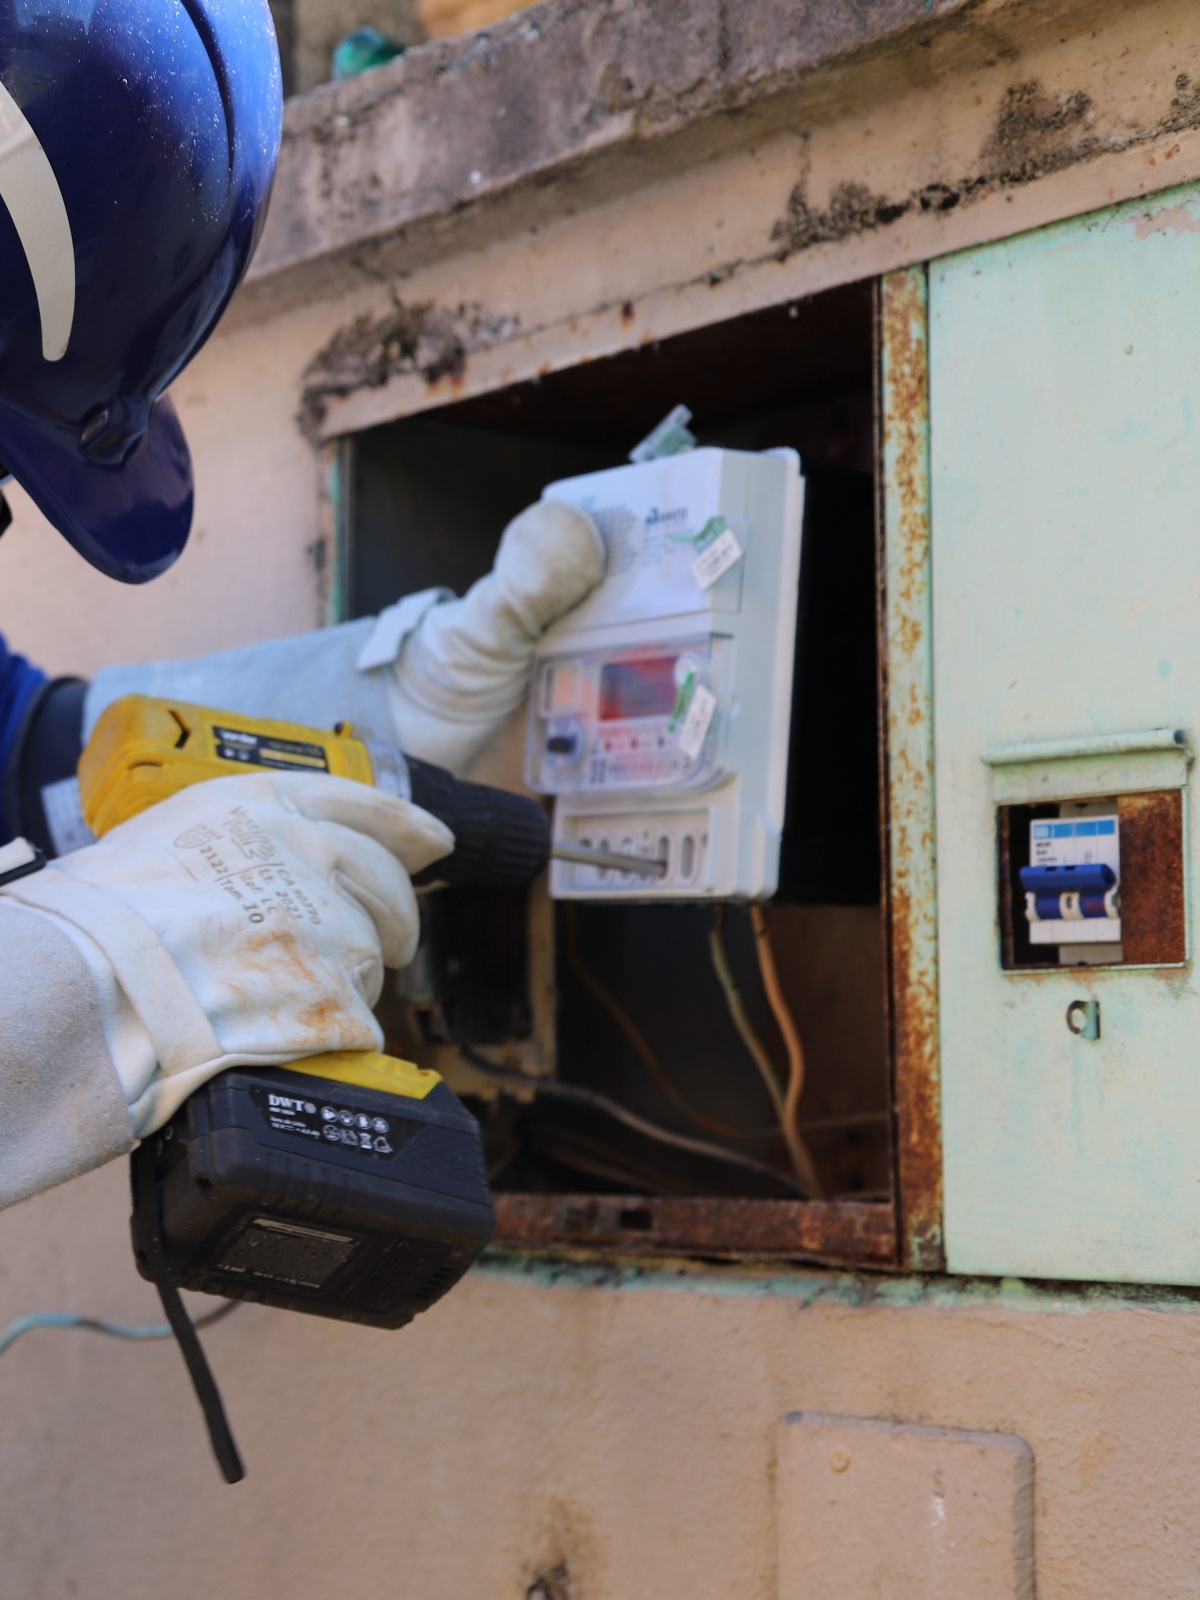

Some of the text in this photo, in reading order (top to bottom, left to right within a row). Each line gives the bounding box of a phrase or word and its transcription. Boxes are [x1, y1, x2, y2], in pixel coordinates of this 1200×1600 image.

[200, 846, 229, 875] 2122
[277, 868, 296, 887] CA
[218, 879, 265, 924] Tam: 10
[268, 1094, 305, 1111] DWT
